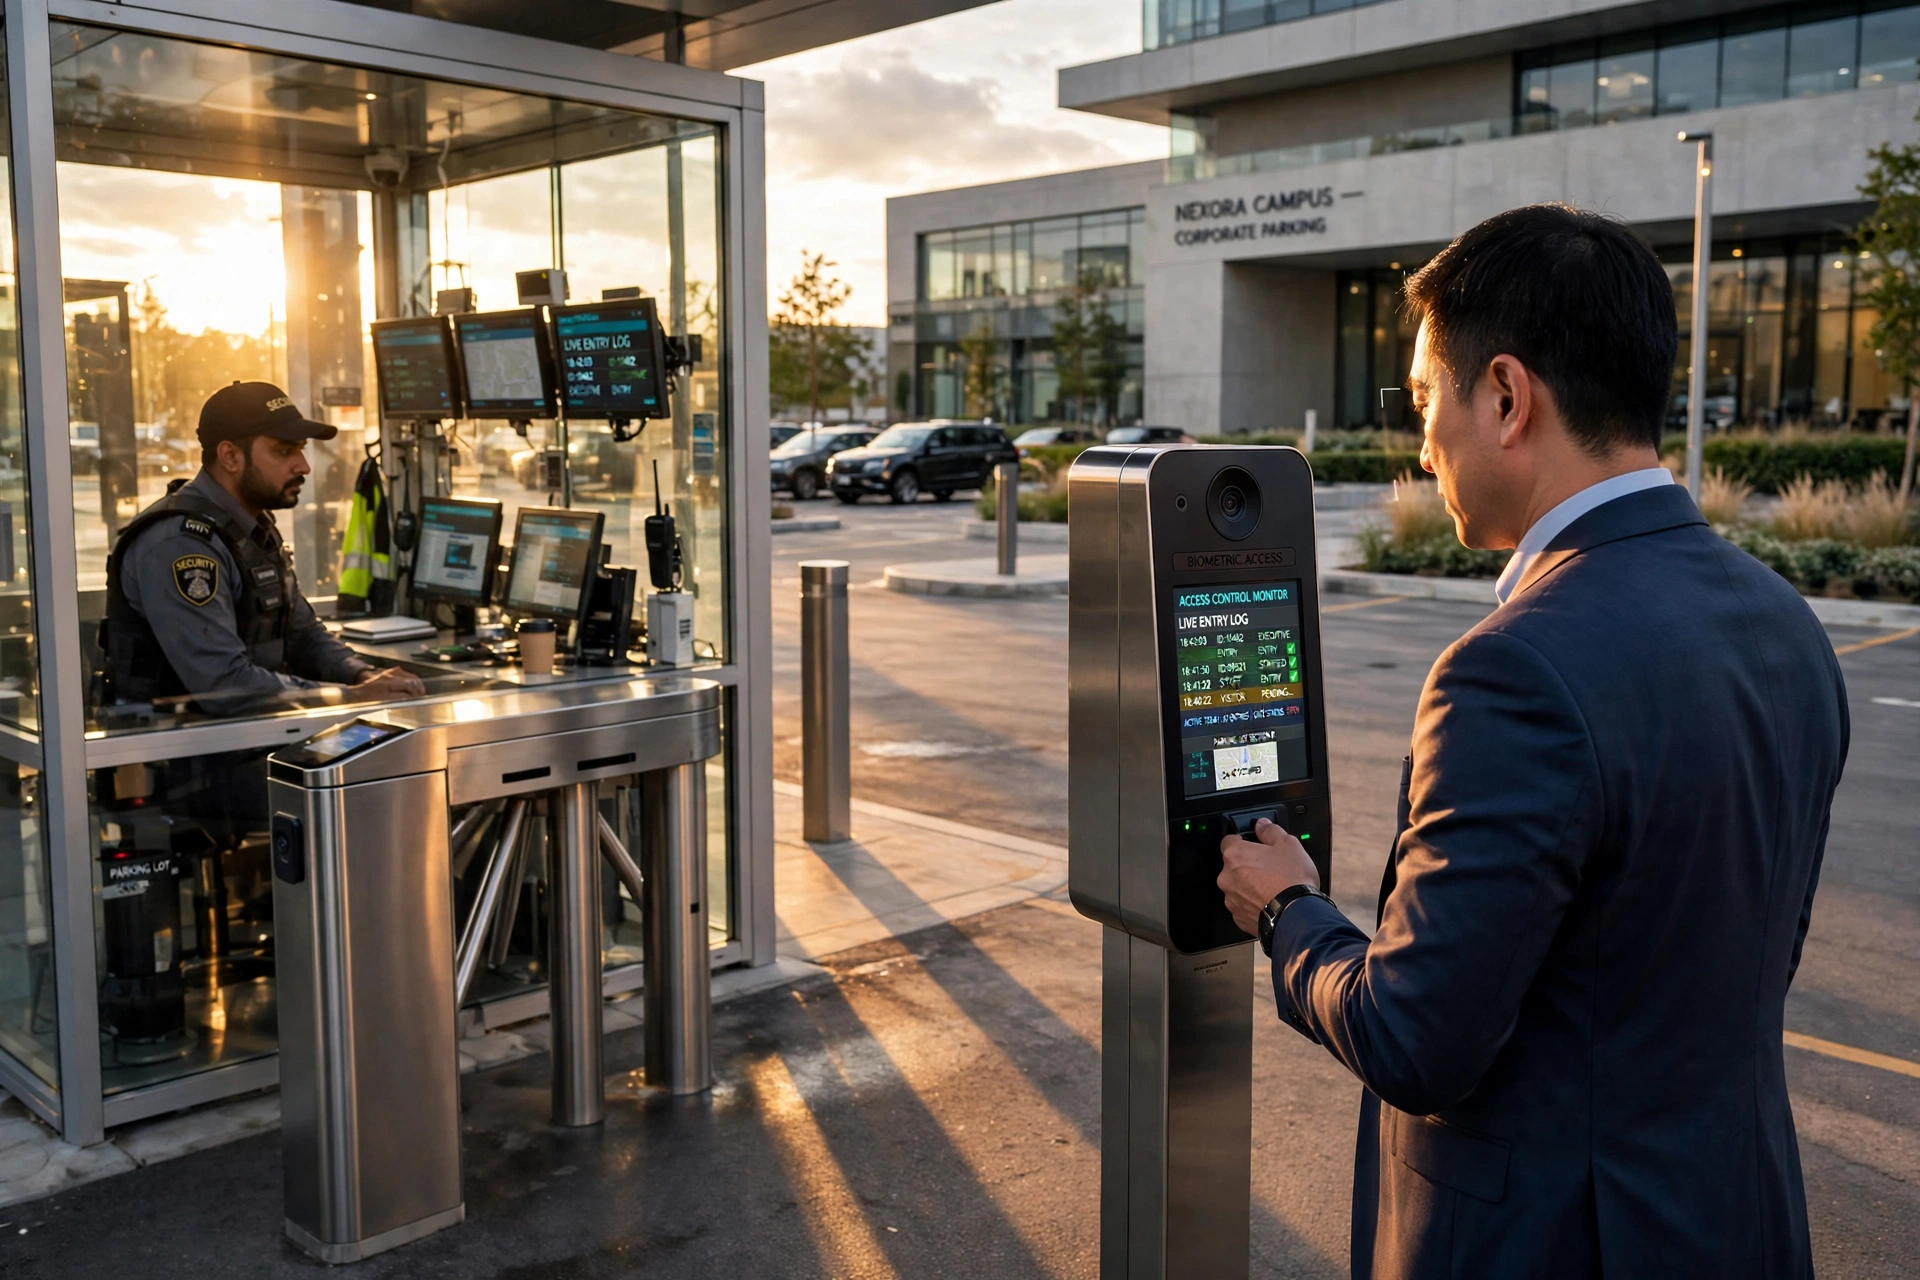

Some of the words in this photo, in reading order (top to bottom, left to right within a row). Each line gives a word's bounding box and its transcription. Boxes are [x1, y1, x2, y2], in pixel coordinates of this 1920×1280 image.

[1175, 197, 1247, 222] NEXORA
[1253, 187, 1333, 213] CAMPUS
[1175, 223, 1256, 246] CORPORATE
[1261, 217, 1326, 238] PARKING
[563, 339, 582, 351] LIVE
[583, 337, 609, 351] ENTRY
[612, 334, 631, 349] LOG
[176, 557, 215, 571] SECURITY
[1187, 554, 1242, 567] BIOMETRIC
[1245, 552, 1283, 565] ACCESS
[1179, 593, 1210, 607] ACCESS
[1212, 591, 1251, 605] CONTROL
[1253, 589, 1288, 602] MONITOR
[1178, 616, 1197, 629] LIVE
[1199, 614, 1228, 628] ENTRY
[1230, 613, 1249, 626] LOG
[109, 863, 151, 879] PARKING
[153, 859, 171, 873] LOT
